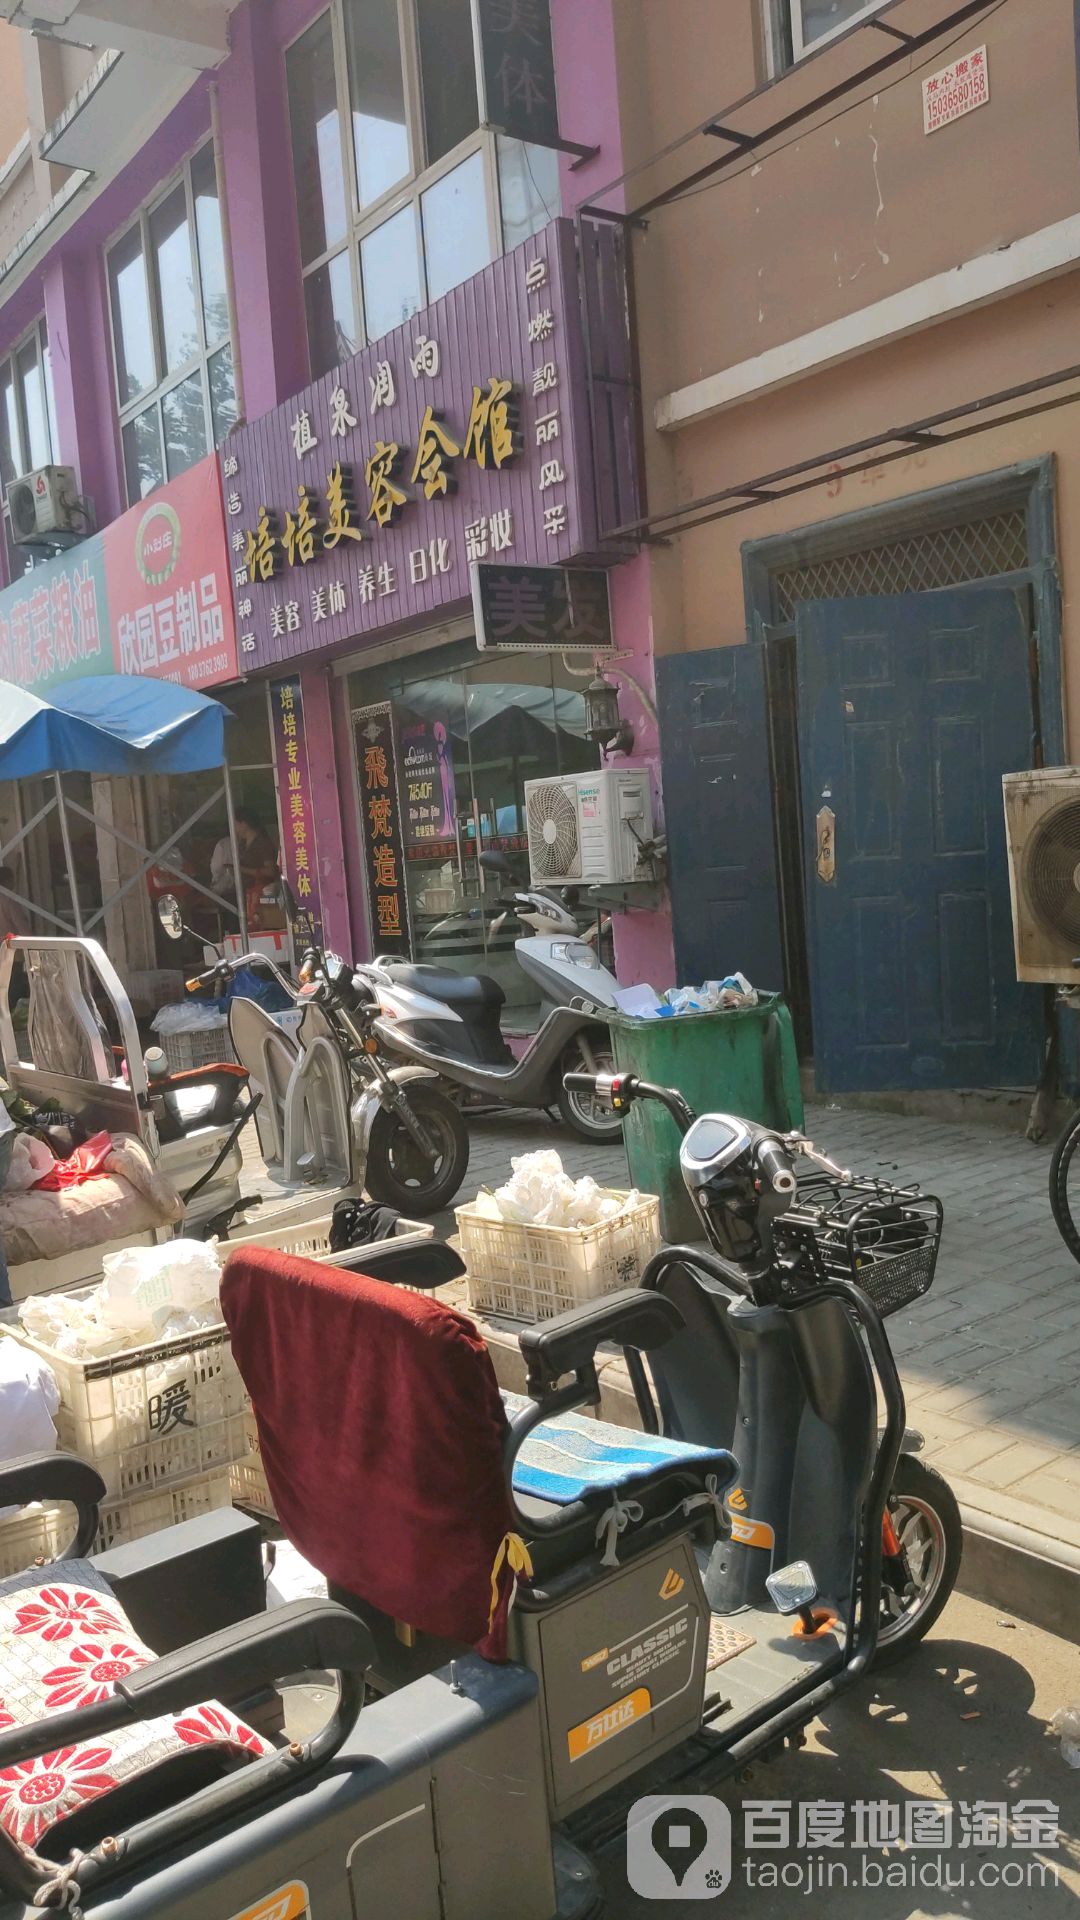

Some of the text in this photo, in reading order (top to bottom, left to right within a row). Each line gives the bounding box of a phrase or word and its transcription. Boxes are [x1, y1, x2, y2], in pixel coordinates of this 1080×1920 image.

[928, 73, 985, 120] 15036580158
[525, 257, 566, 536] 点燃靓丽风采
[245, 377, 514, 584] 培培美容会馆
[224, 455, 256, 653] 缔造美丽神话
[270, 508, 513, 638] 美容 美体 养生 日化 彩妆
[117, 572, 225, 676] 欣园豆制品
[280, 685, 312, 897] 培培专业美容美体
[149, 1379, 195, 1436] 暖
[607, 1618, 688, 1676] CLASSIC
